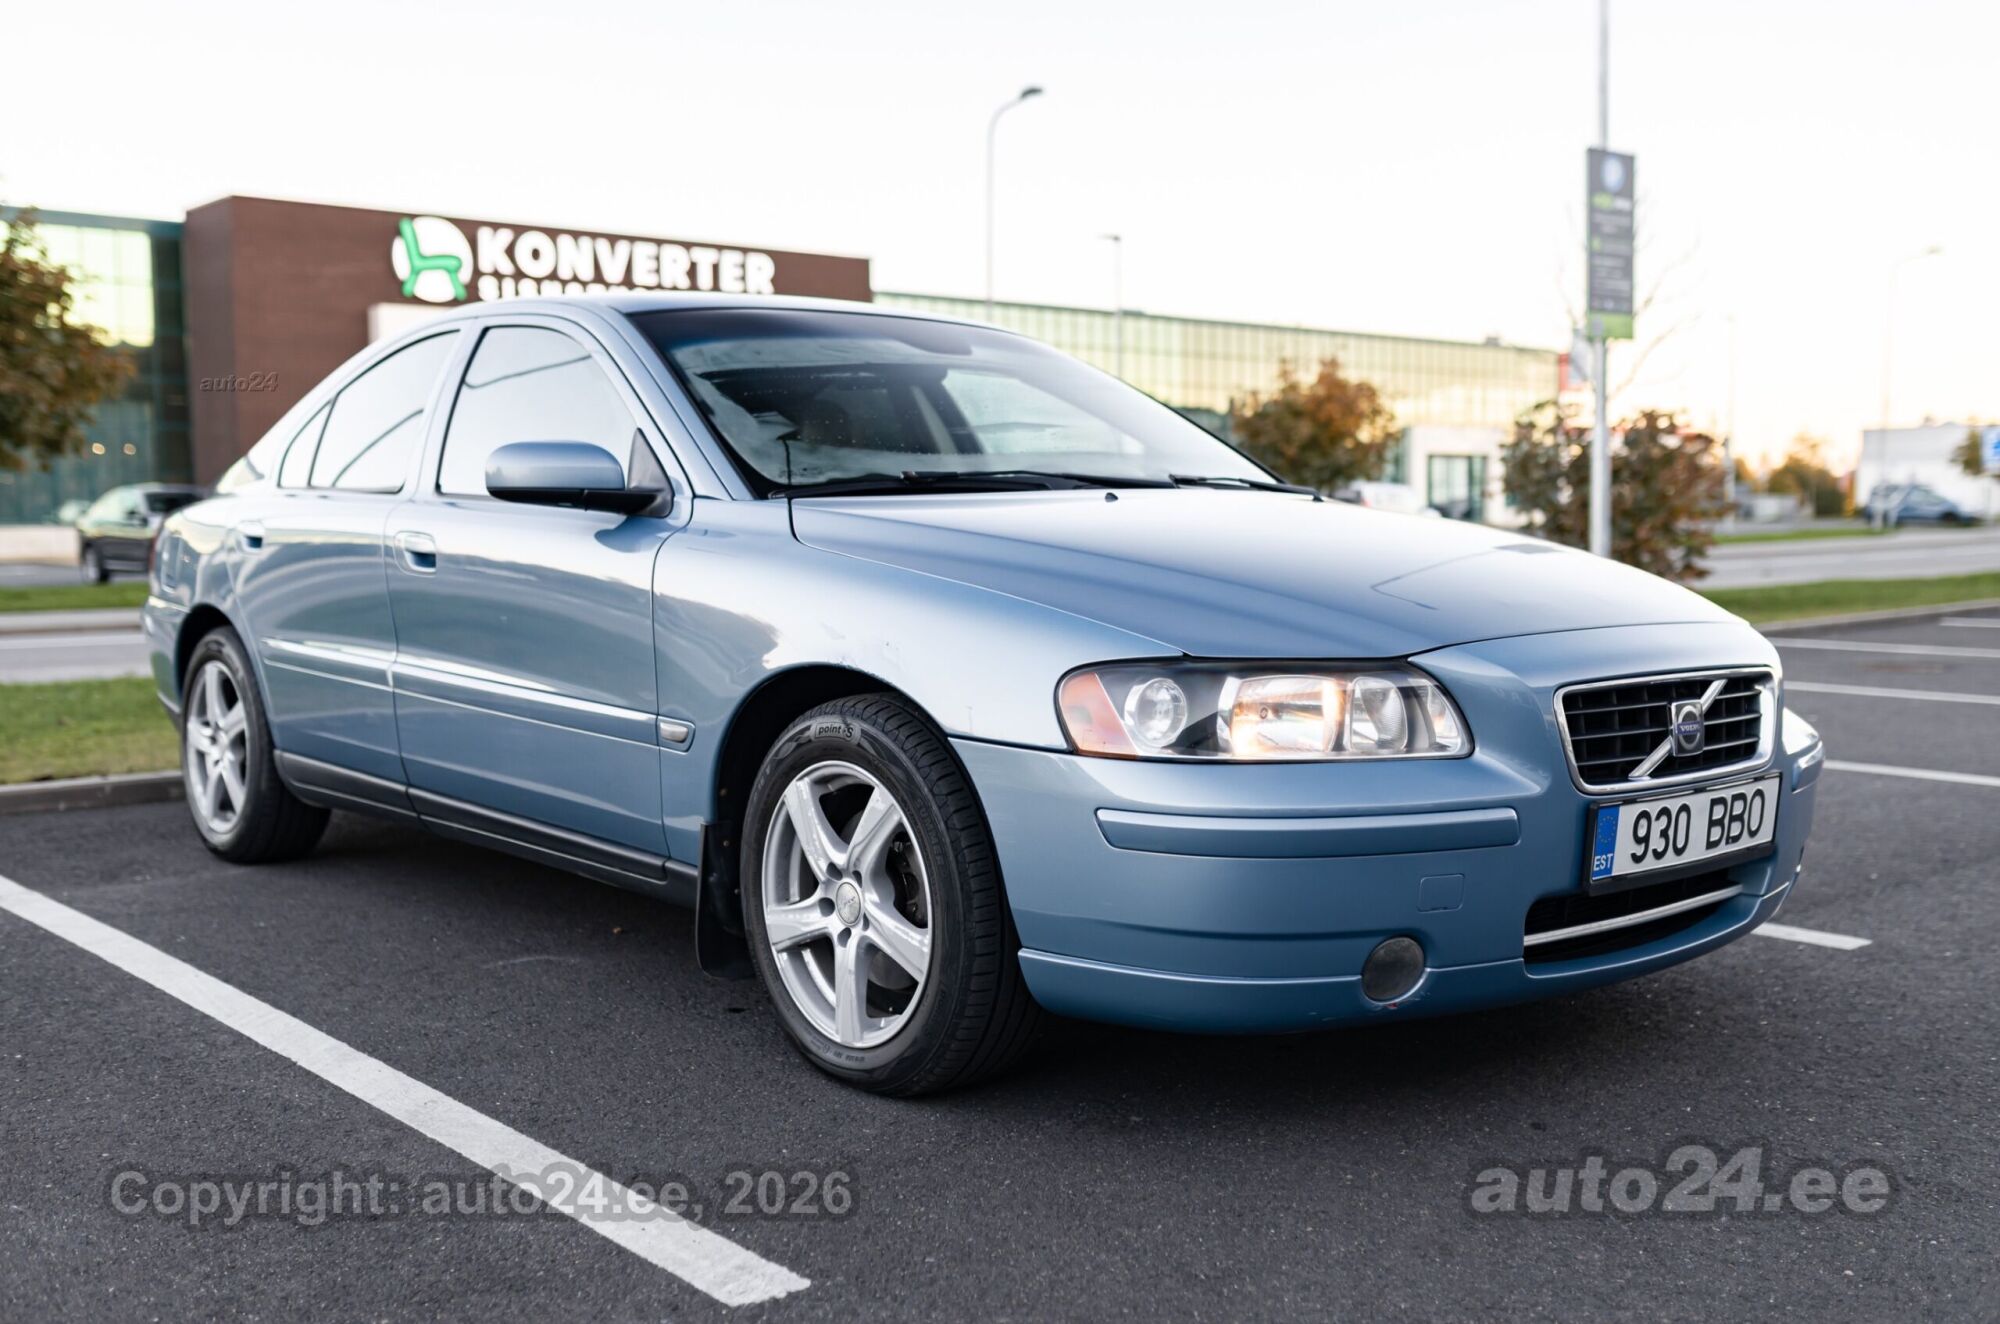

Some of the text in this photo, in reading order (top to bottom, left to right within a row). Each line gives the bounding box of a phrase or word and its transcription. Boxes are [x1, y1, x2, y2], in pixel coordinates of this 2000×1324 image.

[477, 226, 775, 294] KONVERTER
[818, 725, 842, 736] point
[1630, 788, 1766, 864] 930 BBO
[1593, 853, 1614, 871] EST
